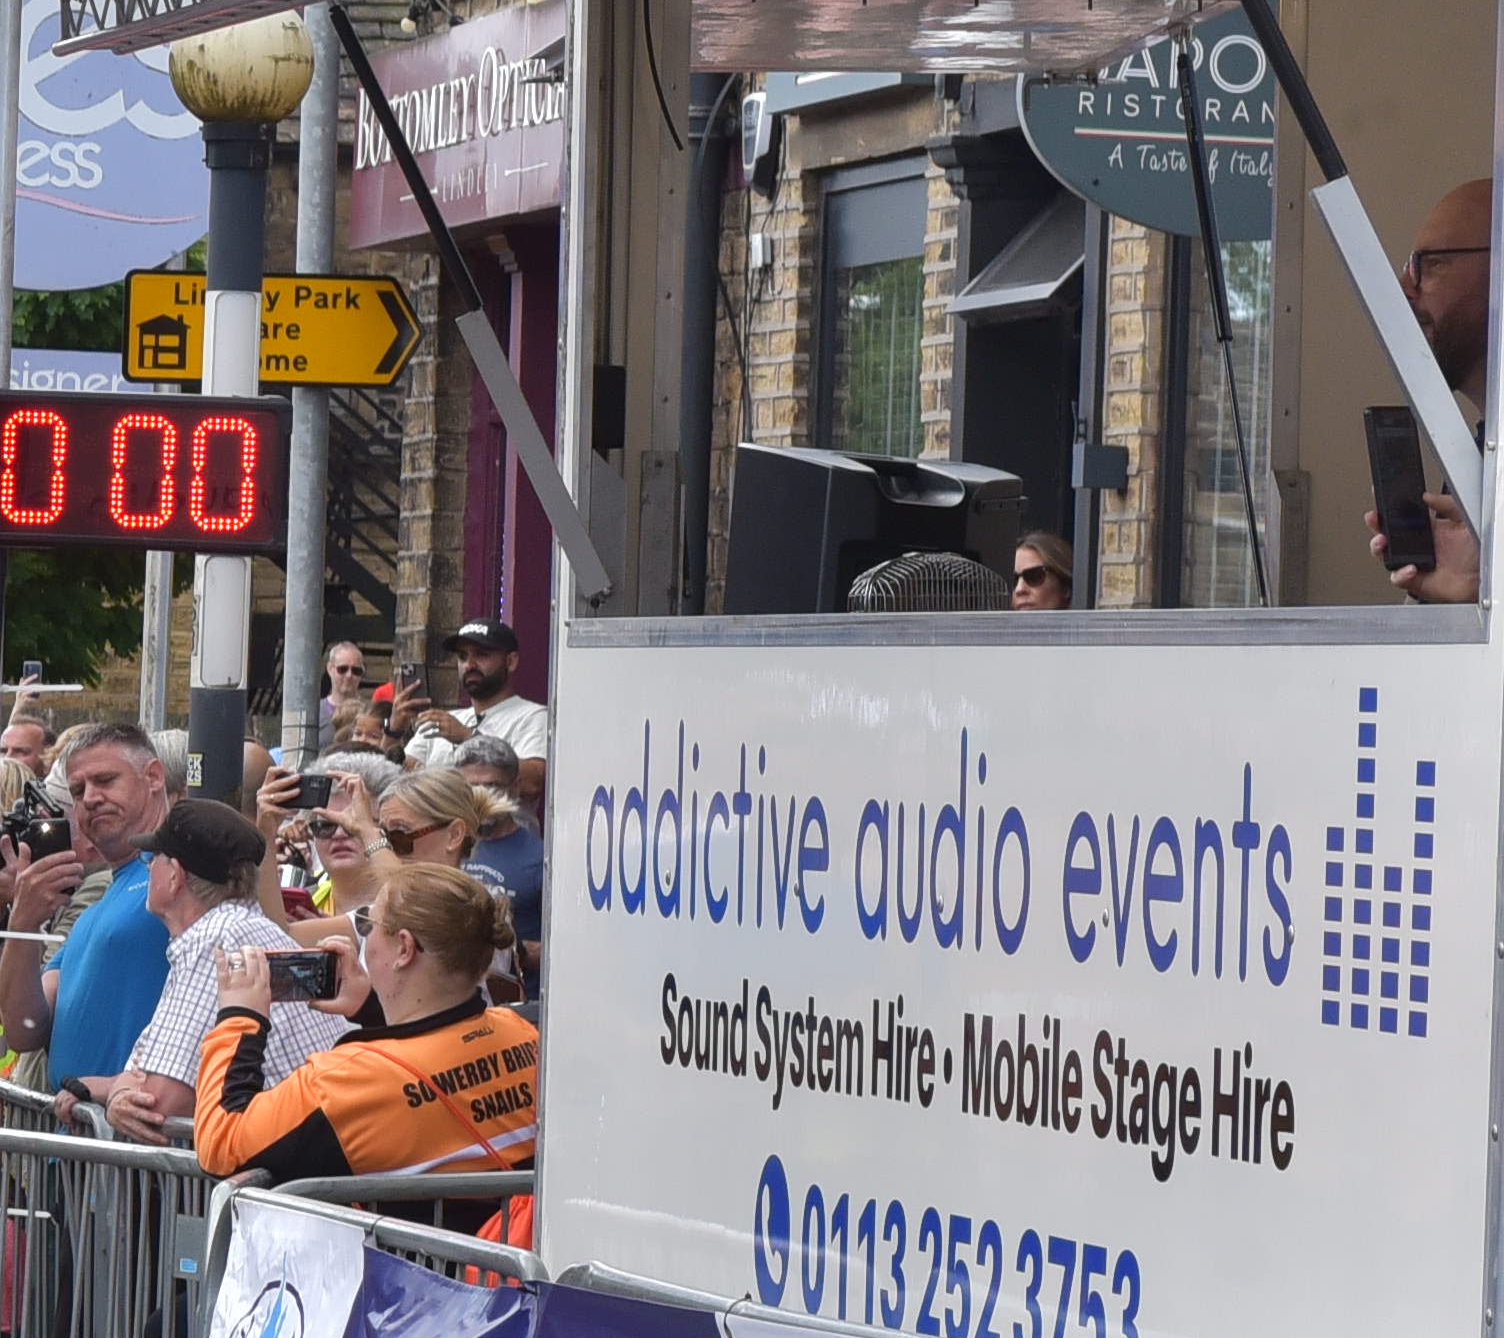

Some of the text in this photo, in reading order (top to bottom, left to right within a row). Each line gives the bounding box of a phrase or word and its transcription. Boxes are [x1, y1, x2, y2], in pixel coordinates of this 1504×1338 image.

[1108, 143, 1124, 170] A
[1136, 144, 1188, 173] Taste
[293, 285, 361, 310] Park
[107, 412, 258, 534] 00
[585, 717, 1296, 988] addictive audio events
[402, 1052, 501, 1108] SOWERBY
[470, 1081, 534, 1123] SNAILS
[660, 972, 1295, 1182] Sound System Hire Mobile Stage Hire
[800, 1182, 907, 1328] 0113
